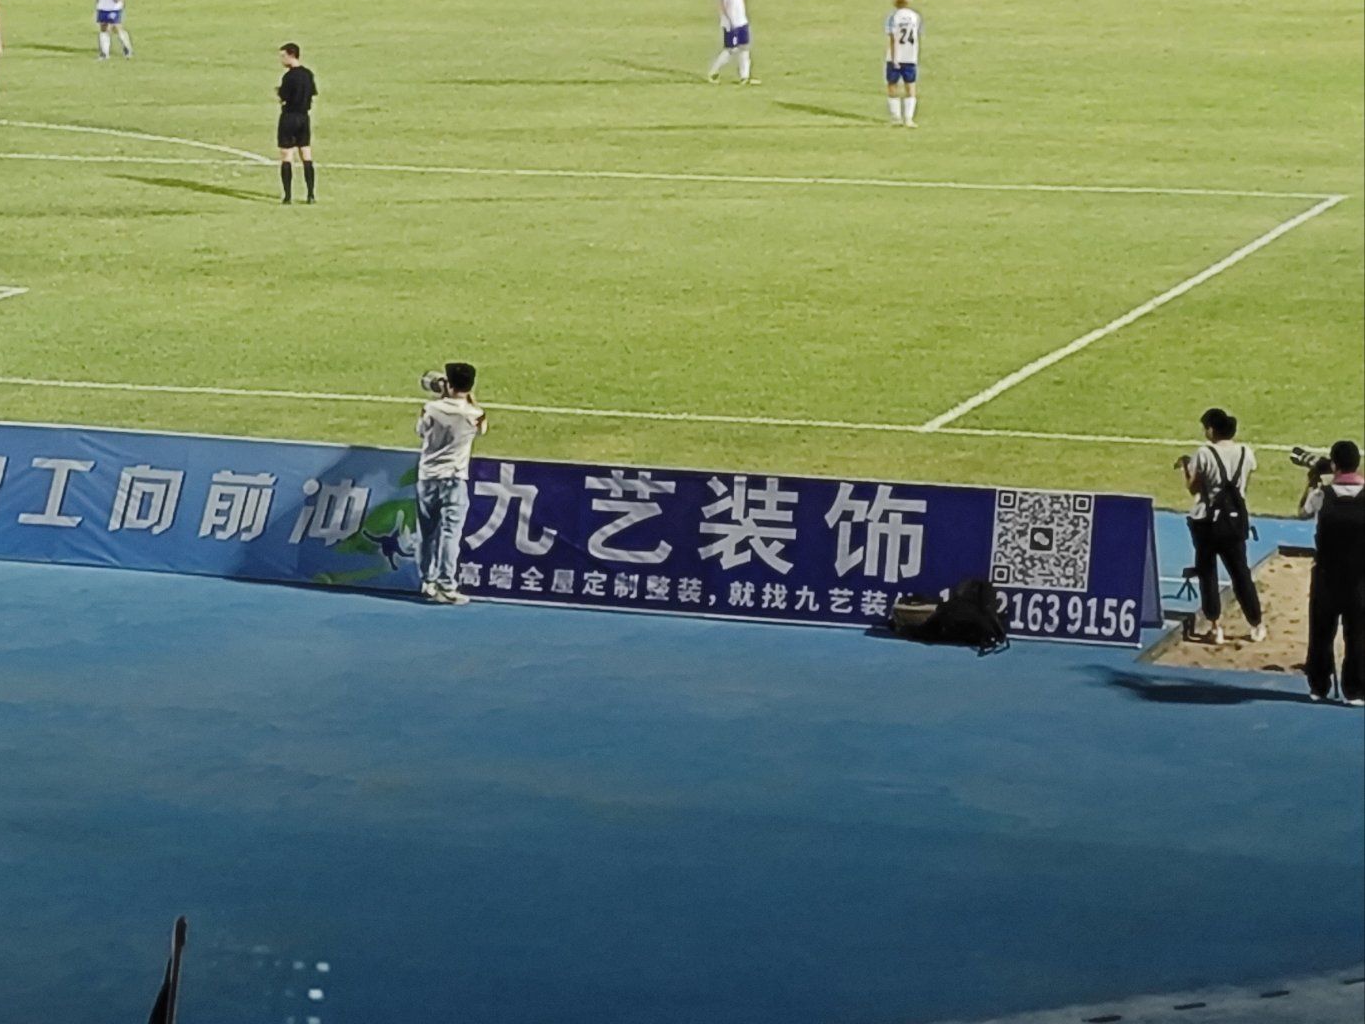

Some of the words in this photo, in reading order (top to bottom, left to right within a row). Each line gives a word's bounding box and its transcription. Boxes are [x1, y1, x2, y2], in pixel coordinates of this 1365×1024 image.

[899, 27, 915, 45] 24
[464, 462, 928, 584] 九艺装饰
[458, 561, 913, 617] 高端全屋定制整装，就找九艺装
